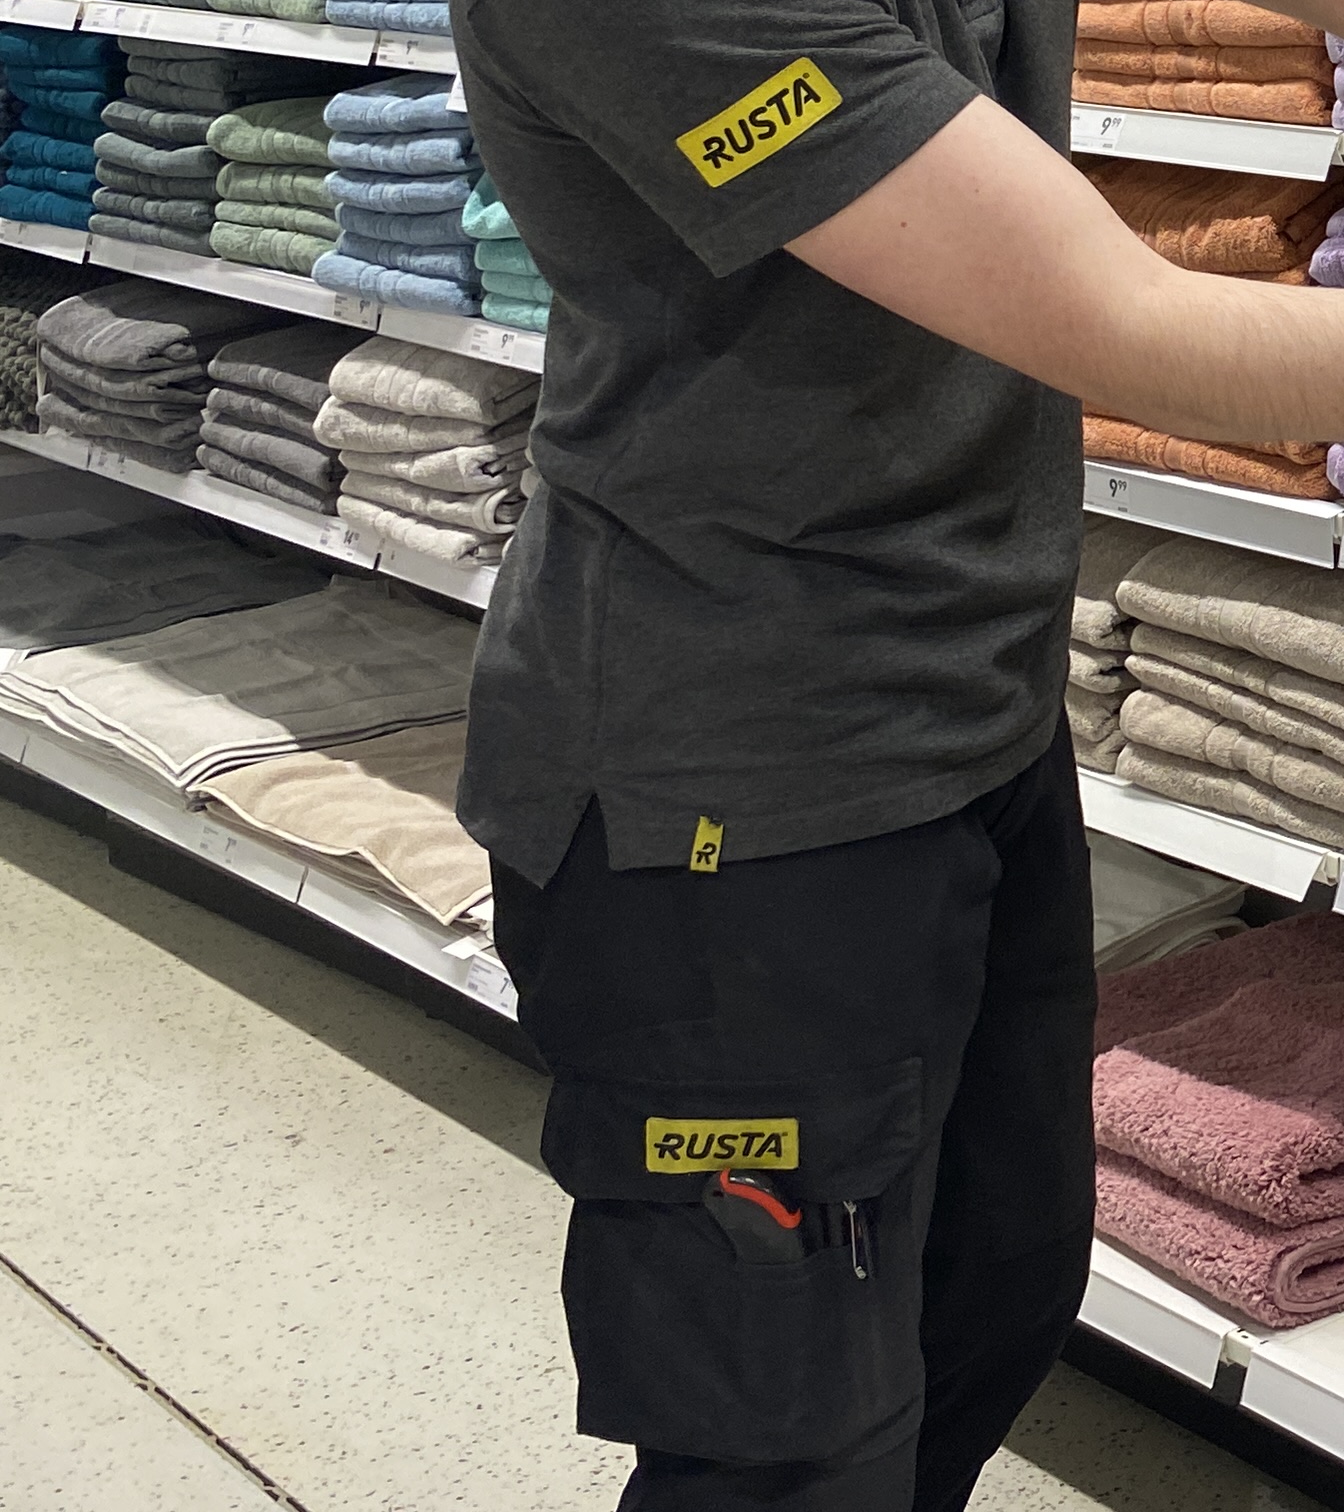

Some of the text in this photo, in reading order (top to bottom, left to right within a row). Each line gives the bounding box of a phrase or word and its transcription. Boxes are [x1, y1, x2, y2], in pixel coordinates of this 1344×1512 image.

[703, 77, 821, 169] RUSTA
[696, 842, 717, 865] R
[653, 1132, 783, 1161] RUSTA
